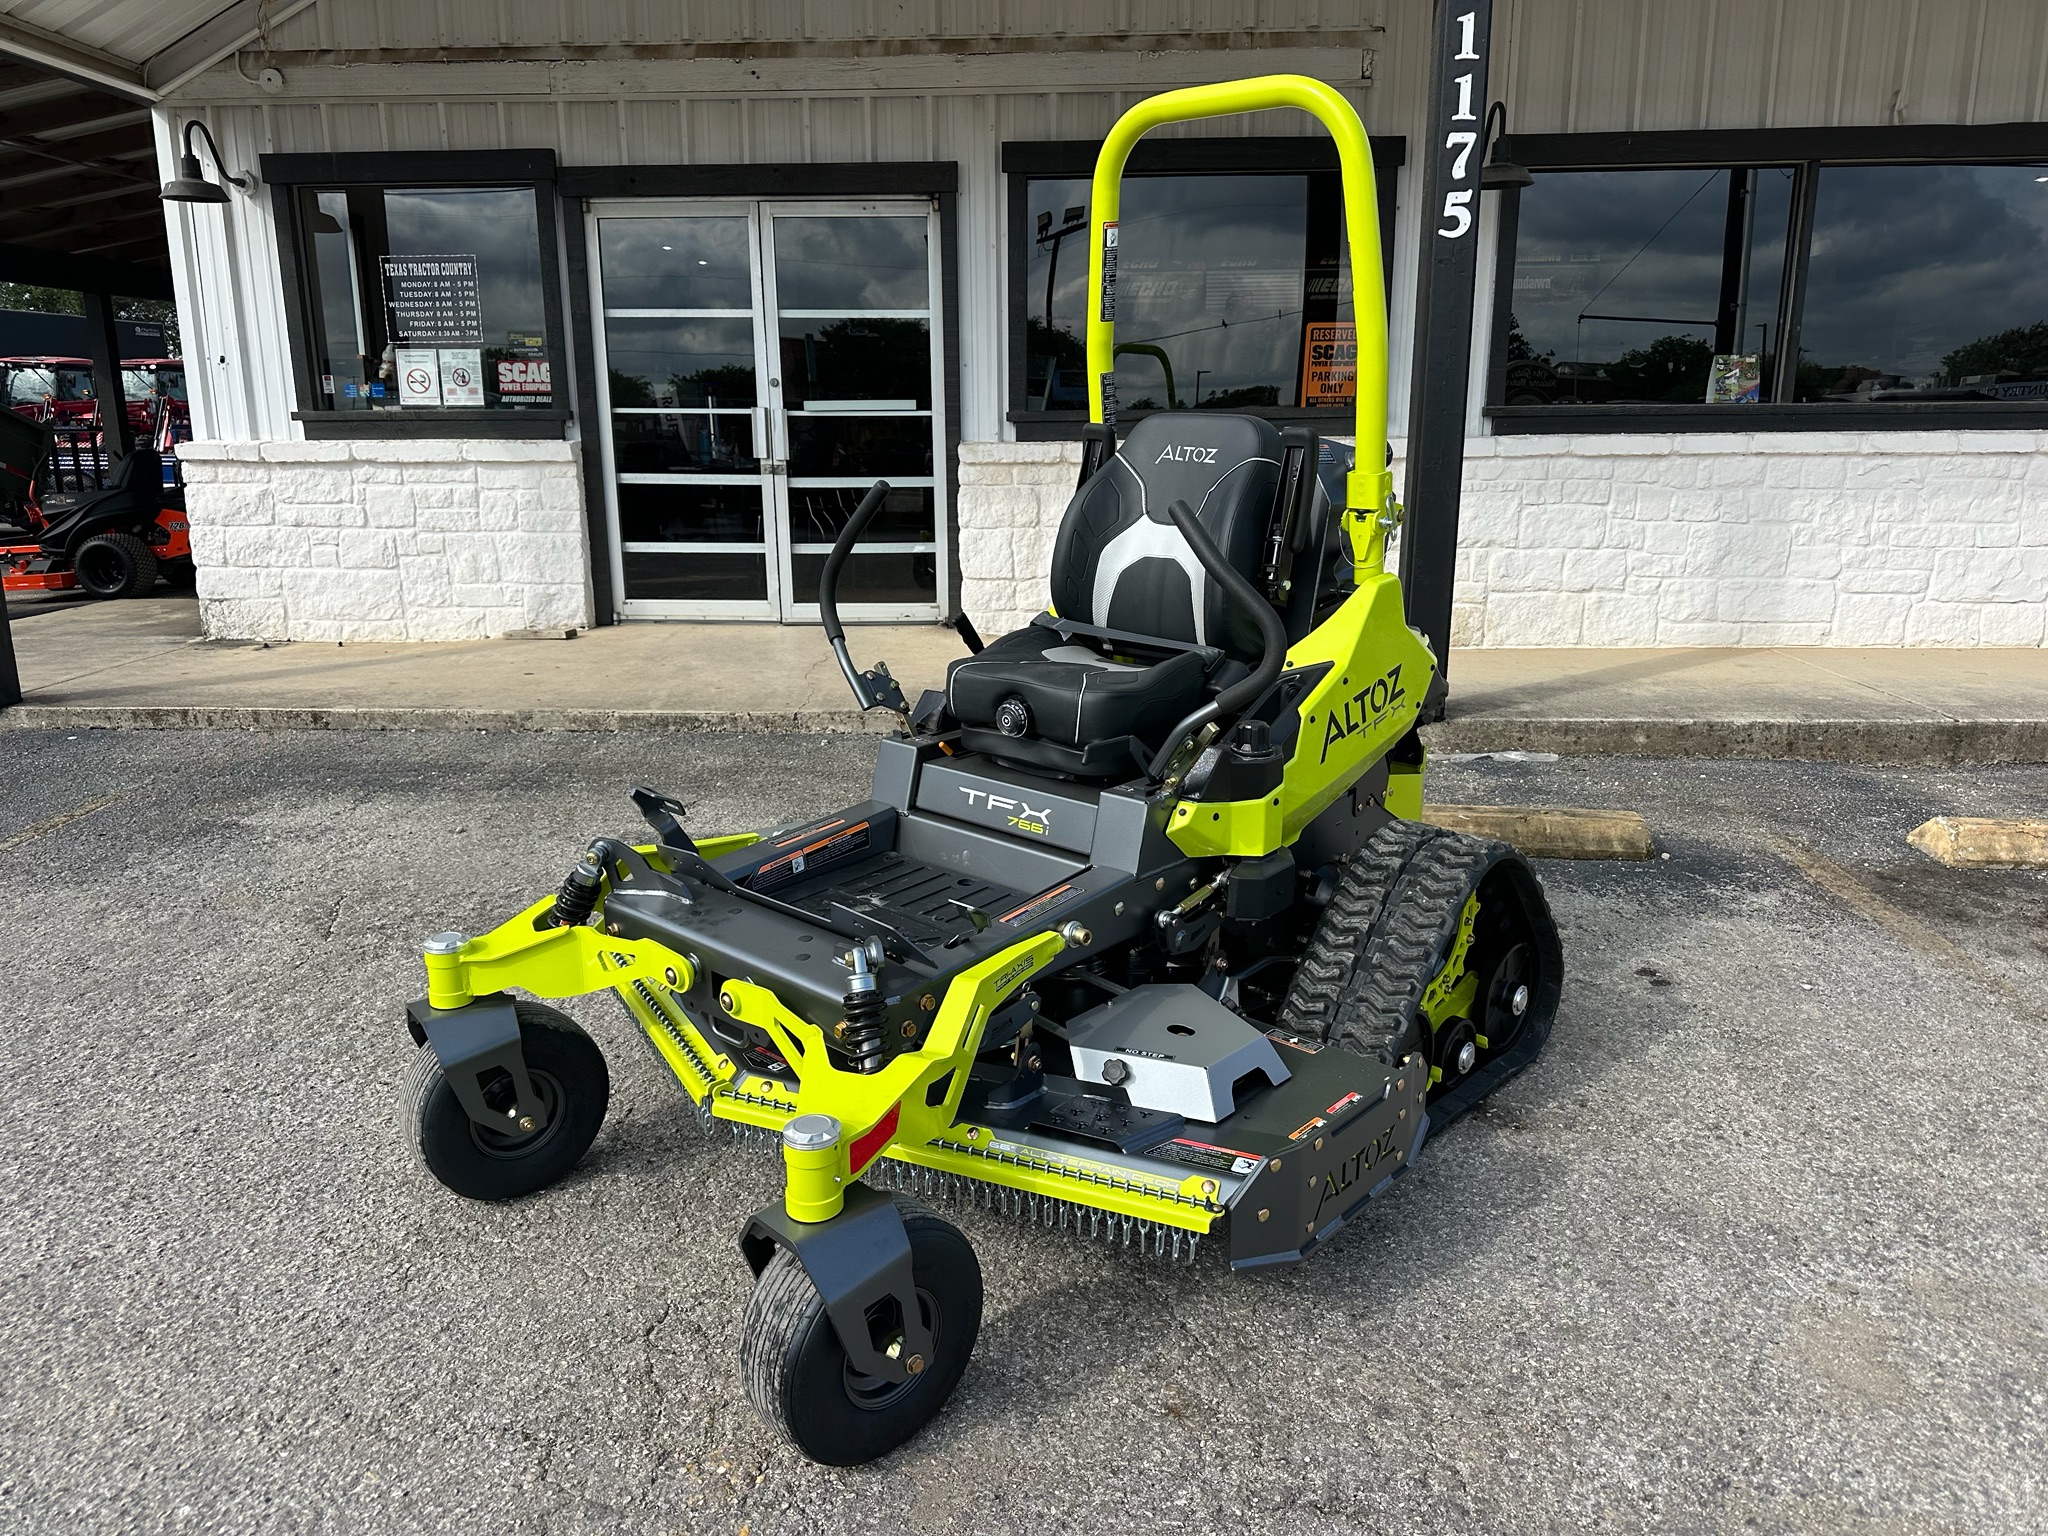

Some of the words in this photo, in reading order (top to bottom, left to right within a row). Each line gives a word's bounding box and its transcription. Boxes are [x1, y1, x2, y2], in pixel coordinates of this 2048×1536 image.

[1437, 12, 1480, 239] 1175
[385, 264, 407, 276] TEXAS
[408, 263, 440, 276] TRACTOR
[440, 262, 472, 276] COUNTRY
[1128, 281, 1178, 296] ECHO
[499, 382, 521, 391] POWER
[1311, 371, 1354, 382] PARKING
[501, 395, 536, 403] AUTHORIZED
[1320, 383, 1344, 394] ONLY
[1154, 443, 1219, 465] ALTOZ
[1320, 663, 1405, 766] ALTOZ
[1356, 696, 1406, 739] TFX
[958, 786, 1052, 825] TFX
[1006, 815, 1049, 836] 766i
[1019, 1148, 1127, 1178] ALL-TERRAIN
[1131, 1172, 1180, 1189] DECK
[1313, 1124, 1396, 1221] ALTOZ
